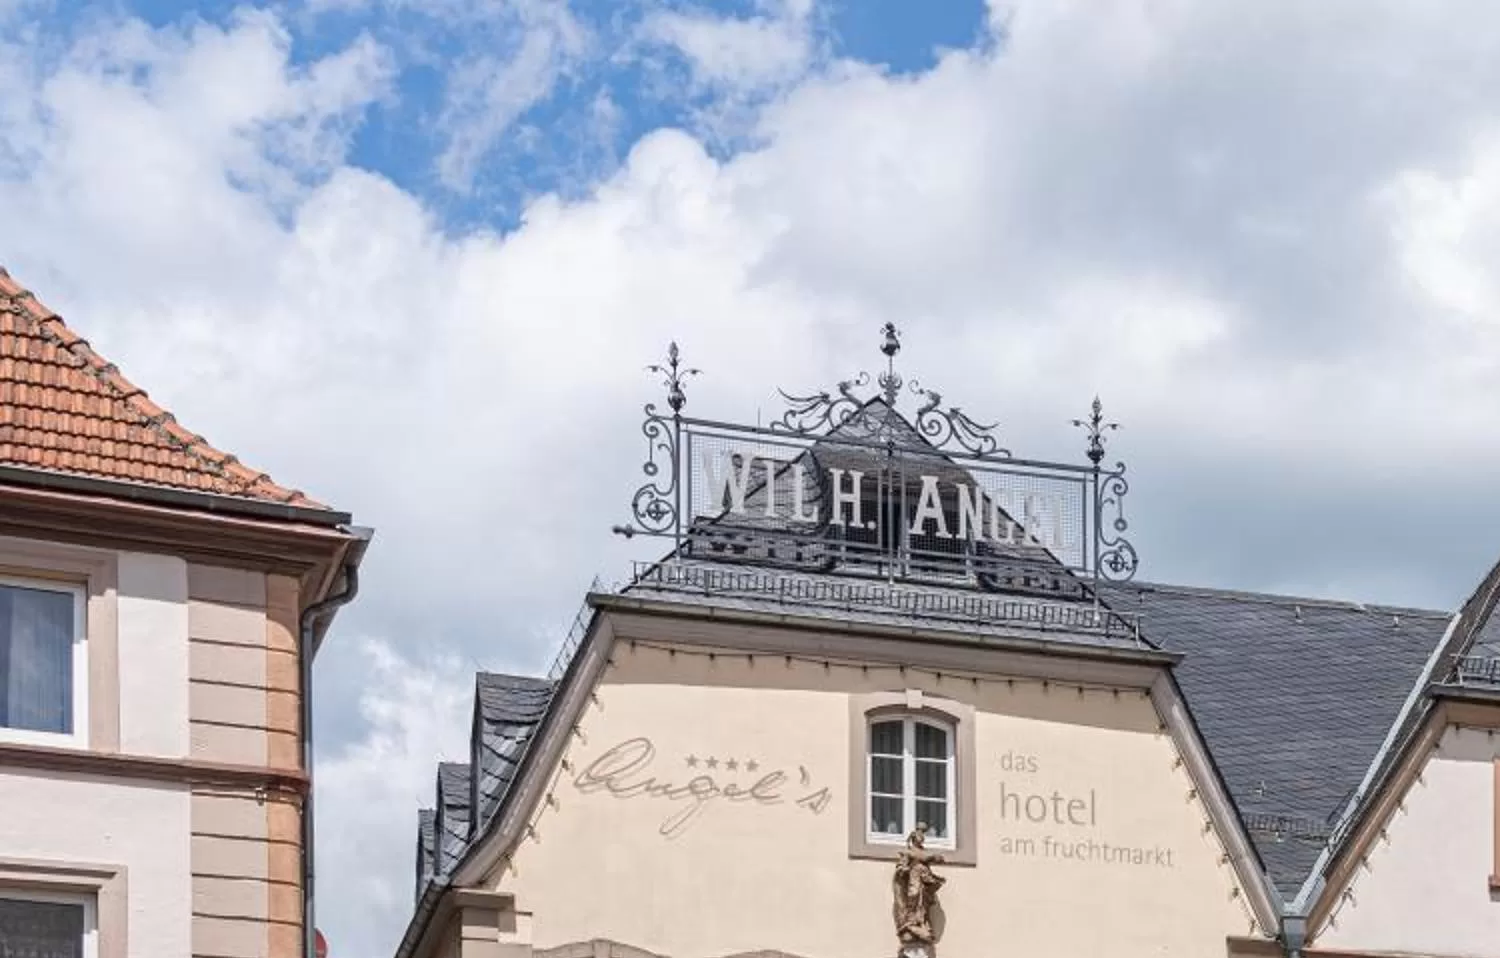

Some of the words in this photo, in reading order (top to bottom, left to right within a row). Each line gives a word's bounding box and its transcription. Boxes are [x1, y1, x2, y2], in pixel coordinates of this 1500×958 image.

[702, 448, 875, 529] WILH.
[1000, 750, 1038, 773] das
[1000, 781, 1096, 827] hotel
[1000, 836, 1035, 856] am
[1044, 835, 1174, 868] fruchtmarkt
